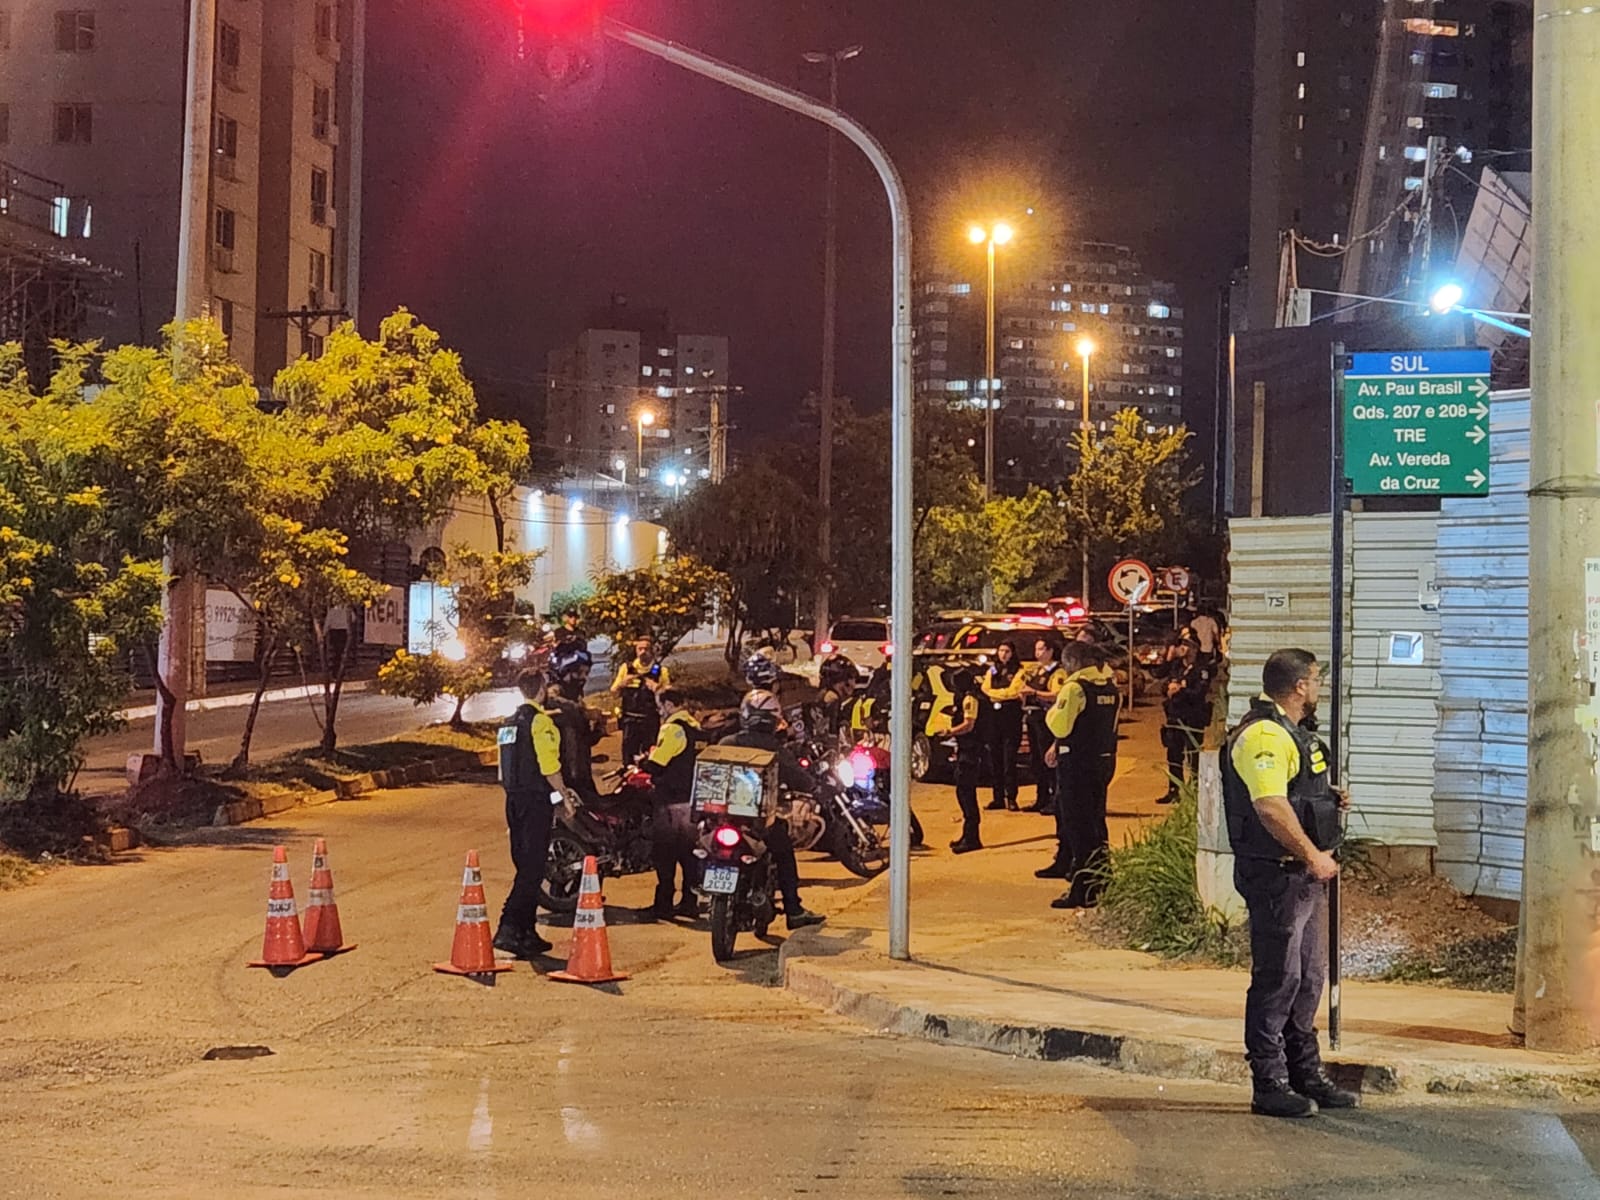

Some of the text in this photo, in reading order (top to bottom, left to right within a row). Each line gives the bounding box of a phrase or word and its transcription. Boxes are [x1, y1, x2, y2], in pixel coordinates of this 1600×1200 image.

[1390, 355, 1430, 372] SUL
[1358, 380, 1462, 396] Av. Pau Brasil
[1352, 404, 1468, 420] Qds. 207 e 208
[1393, 428, 1427, 442] TRE
[1369, 452, 1451, 467] Av. Vereda
[1380, 475, 1440, 490] da Cruz
